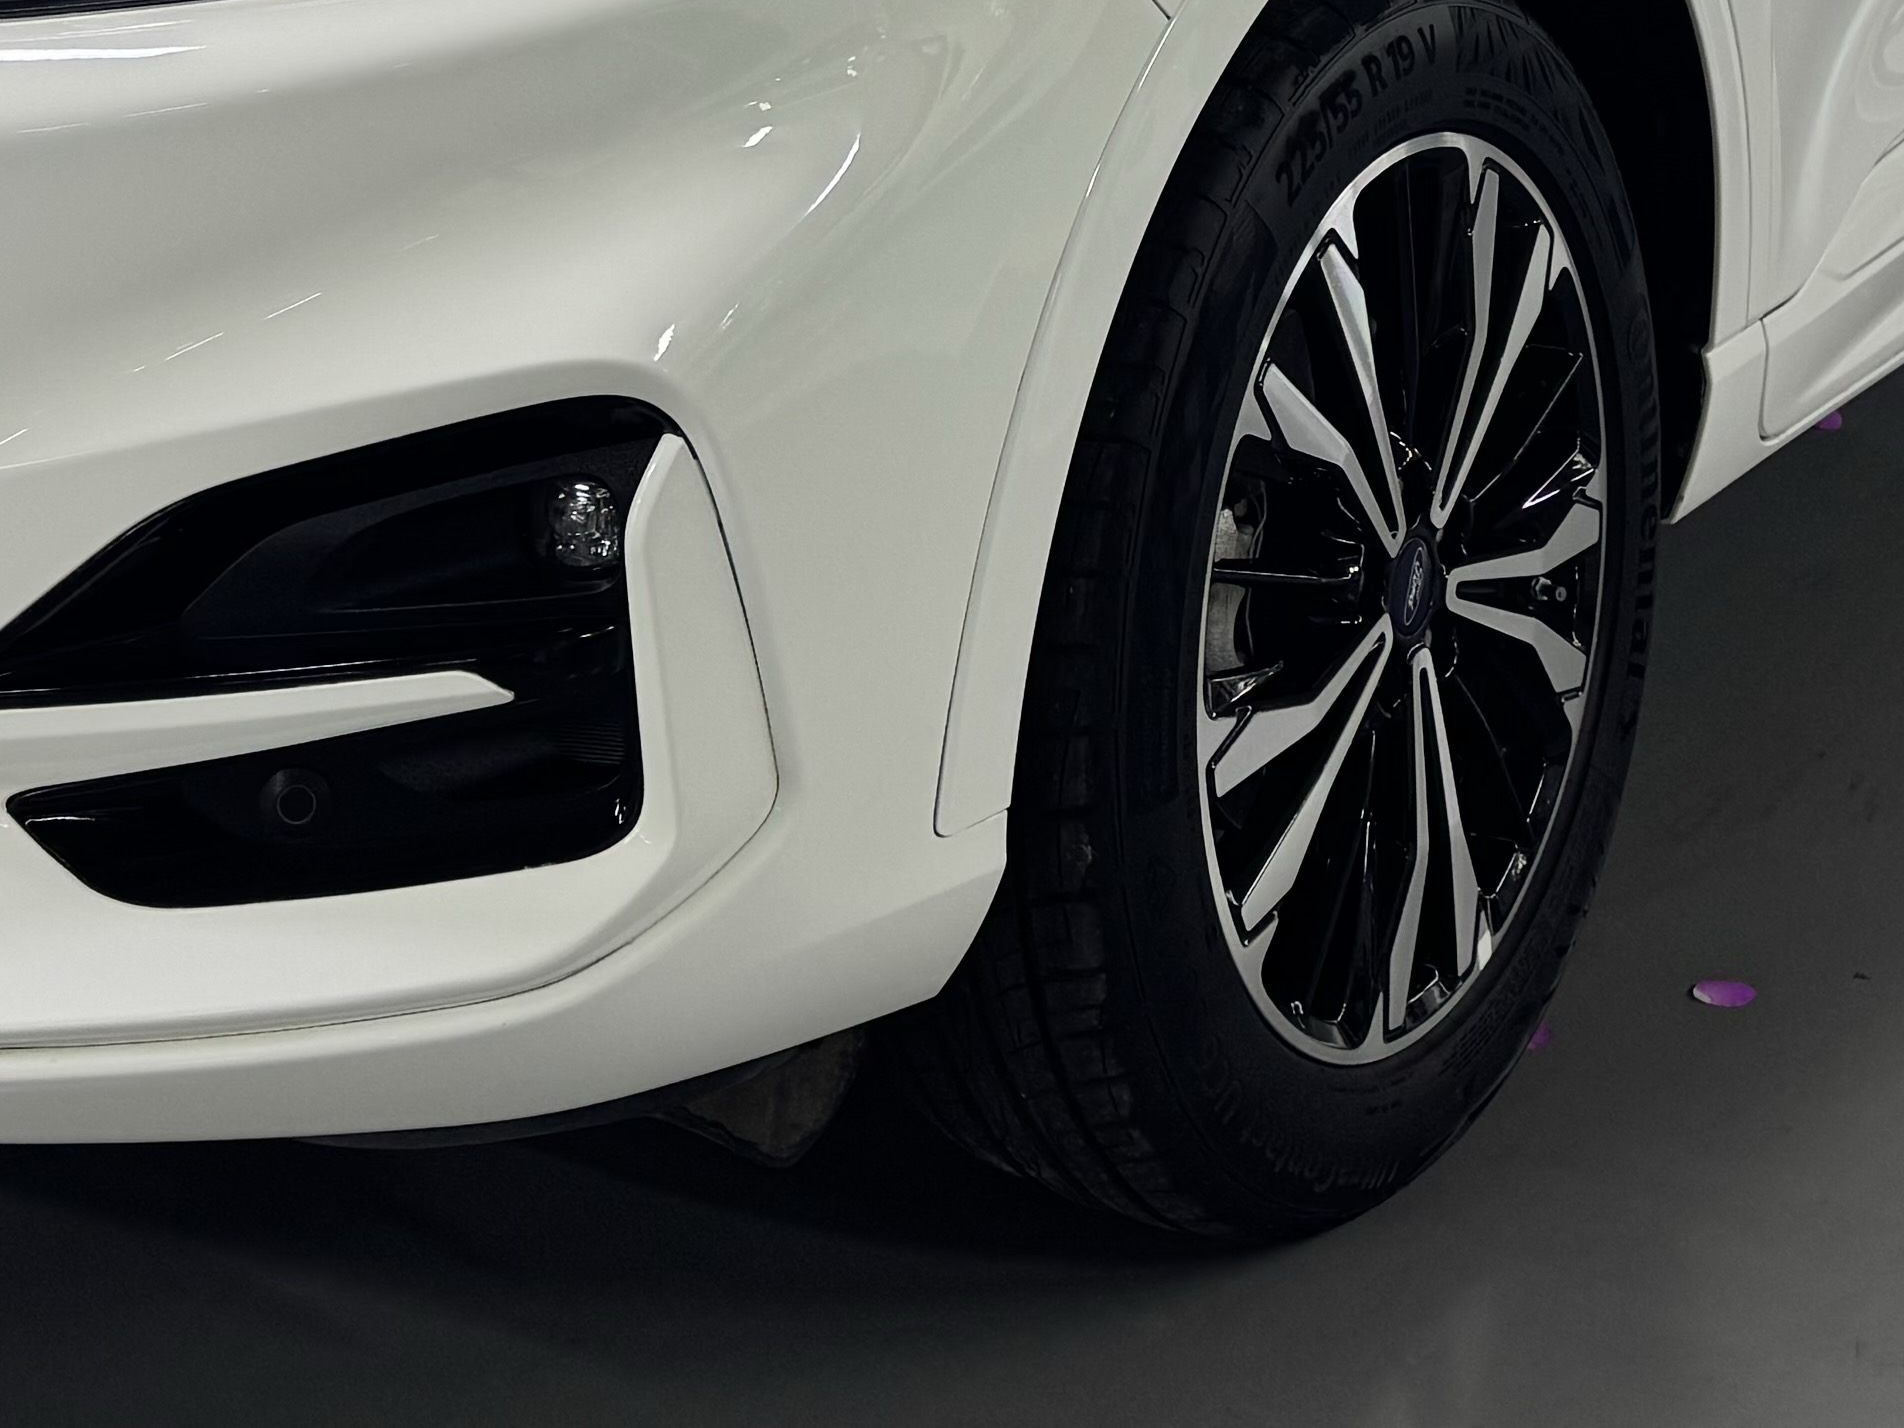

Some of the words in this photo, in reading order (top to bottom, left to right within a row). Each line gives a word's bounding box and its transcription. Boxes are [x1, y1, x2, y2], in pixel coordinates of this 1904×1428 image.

[1275, 67, 1363, 207] 225/55
[1361, 55, 1387, 97] R
[1418, 24, 1436, 65] V
